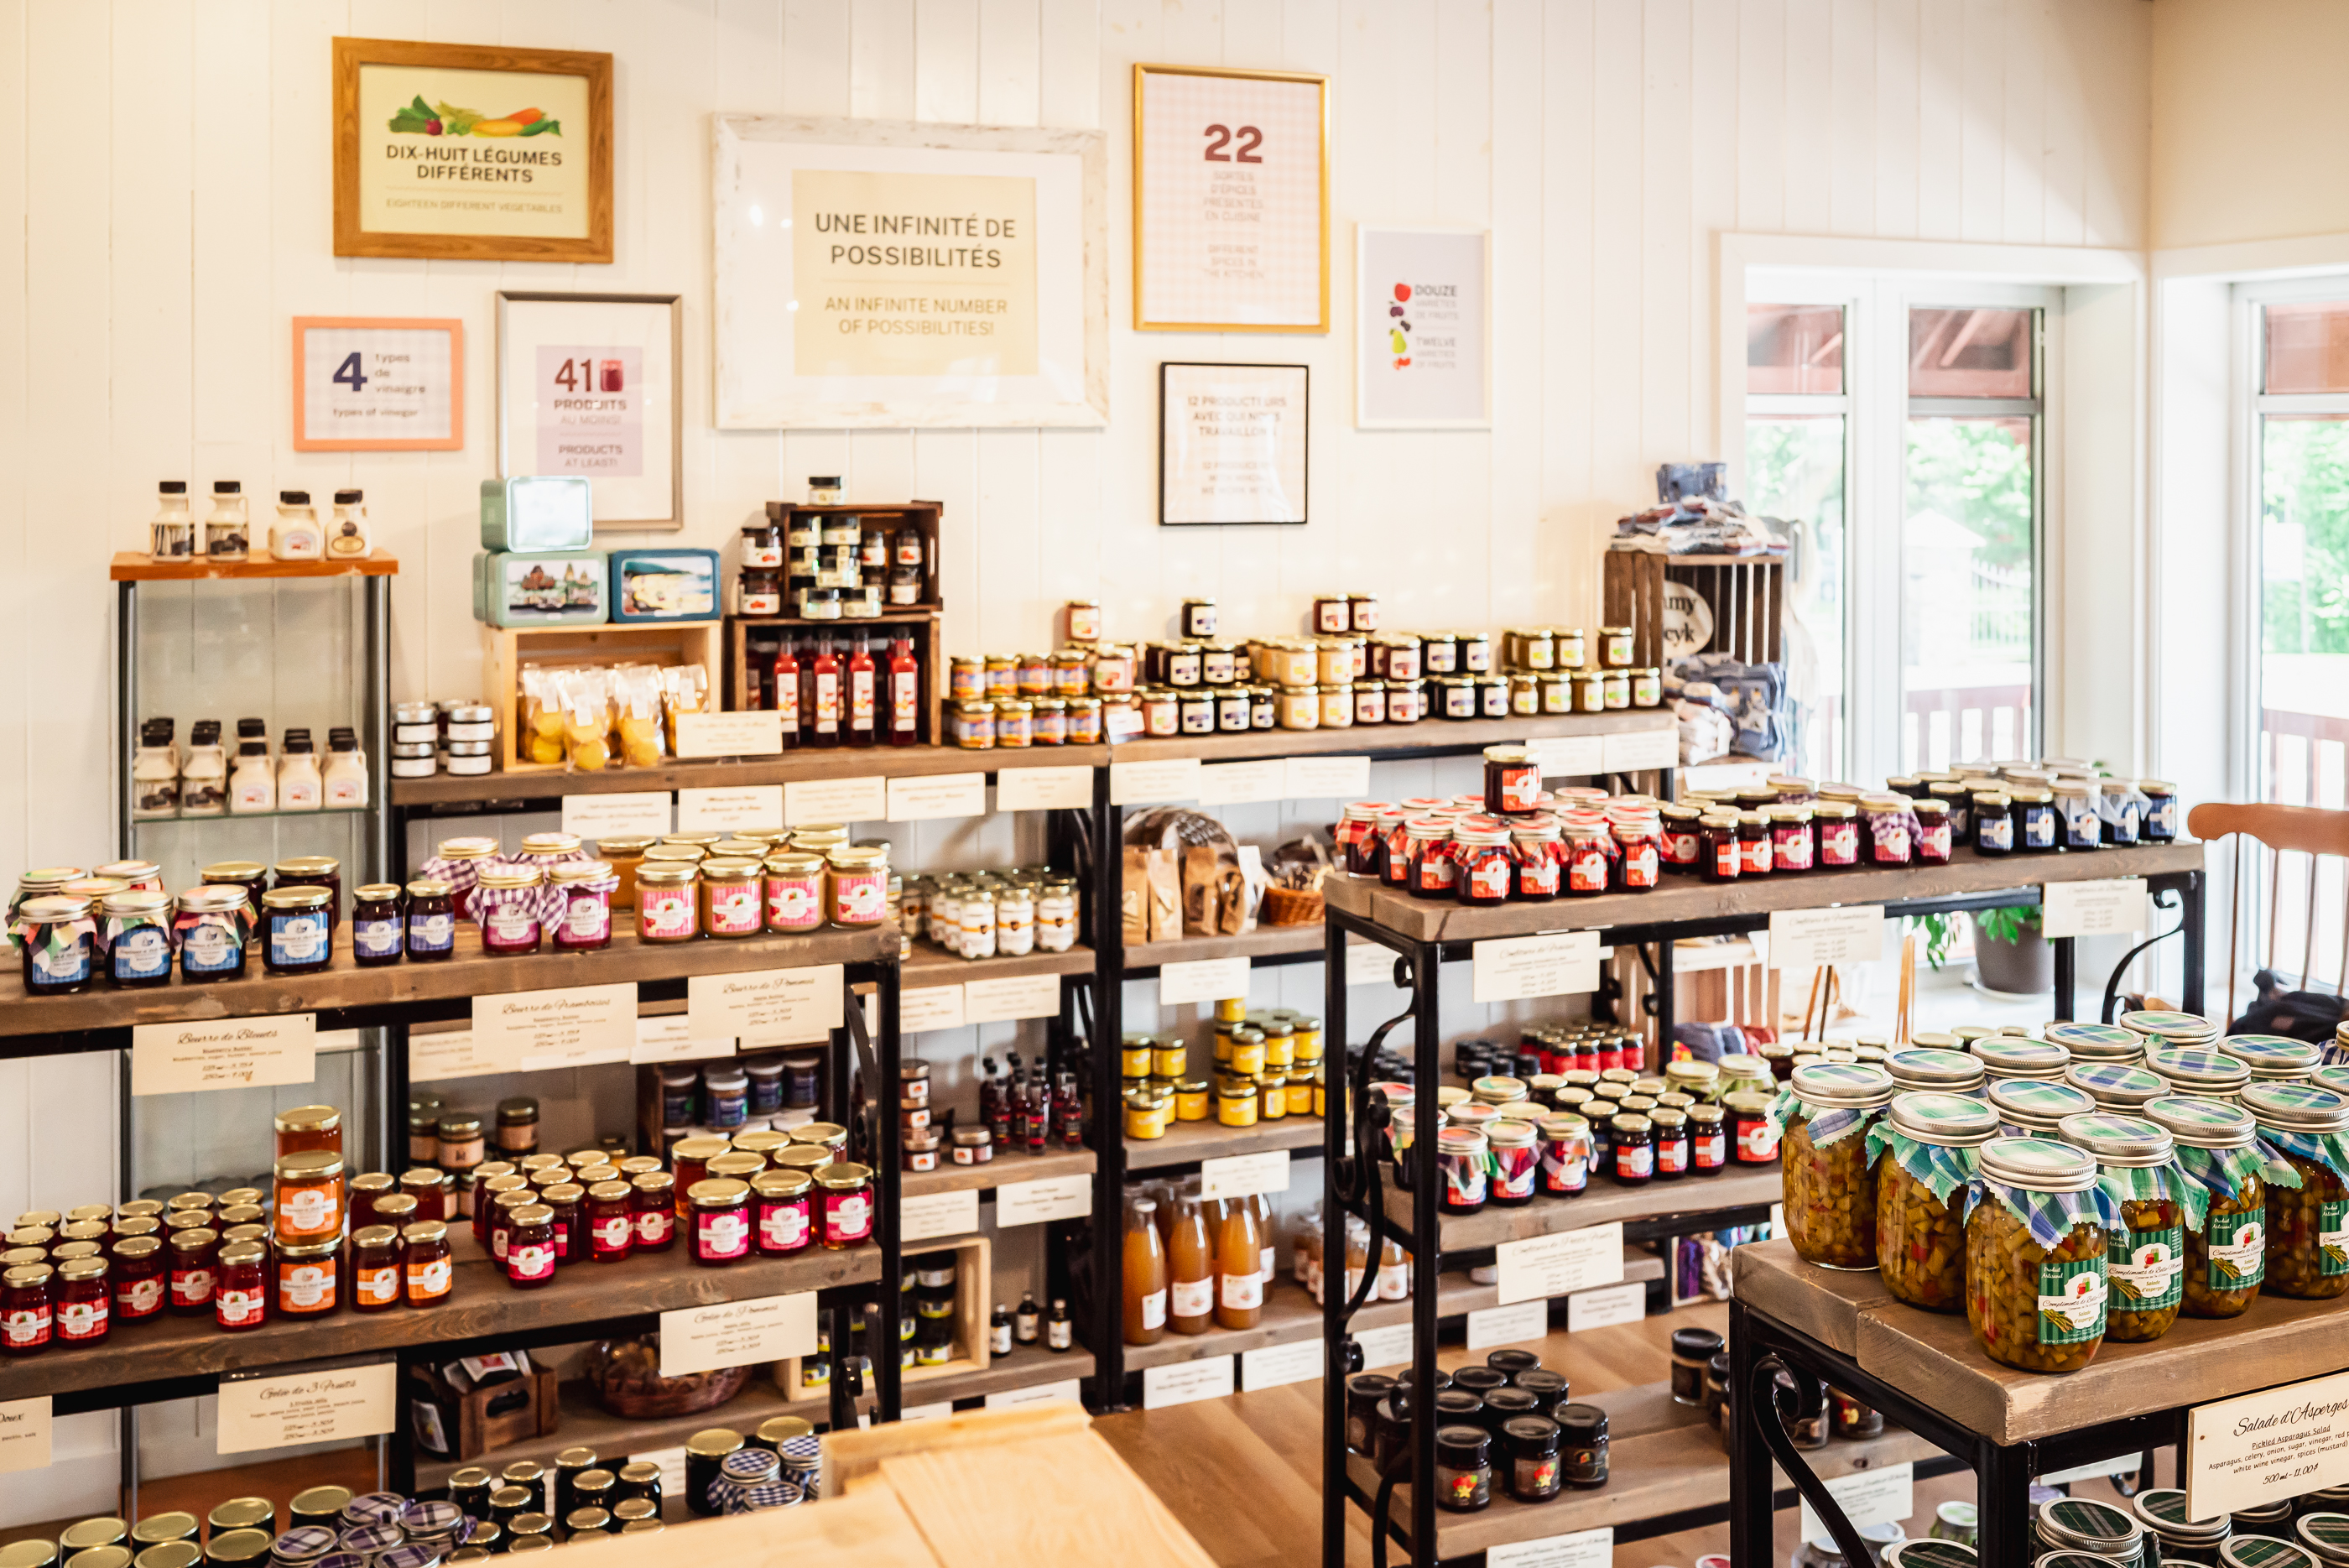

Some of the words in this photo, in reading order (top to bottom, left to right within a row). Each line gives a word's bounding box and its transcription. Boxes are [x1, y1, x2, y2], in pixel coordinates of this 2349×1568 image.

[1203, 124, 1263, 164] 22
[387, 144, 469, 162] DIX-HUIT
[473, 145, 562, 166] LÉGUMES
[417, 163, 534, 184] DIFFÉRENTS
[815, 212, 867, 234] UNE
[873, 213, 980, 237] INFINITÉ
[985, 219, 1016, 238] DE
[831, 243, 1002, 268] POSSIBILITÉS
[1414, 284, 1457, 298] DOUZE
[825, 296, 850, 311] AN
[855, 296, 929, 313] INFINITE
[933, 298, 1008, 315] NUMBER
[839, 318, 862, 335] OF
[867, 319, 995, 336] POSSIBILITIES!
[375, 353, 410, 363] types
[333, 351, 368, 393] 4
[375, 369, 391, 378] de
[555, 357, 591, 393] 41
[375, 386, 426, 395] vinaigre
[333, 408, 363, 418] types
[366, 408, 377, 416] of
[380, 409, 419, 418] vinegar
[554, 399, 628, 411] PRODUITS
[558, 445, 623, 455] PRODUCTS
[177, 1032, 220, 1044] Beurre
[221, 1032, 234, 1041] de
[2108, 1267, 2147, 1275] Compliments
[2042, 1300, 2080, 1308] Compliments
[2232, 1413, 2279, 1437] Salade
[2279, 1399, 2349, 1425] d'Asperges
[2252, 1438, 2276, 1451] Pickled
[2277, 1430, 2311, 1444] Asparagus
[2313, 1424, 2331, 1435] Salad
[2208, 1458, 2243, 1471] Asparagus,
[2244, 1451, 2265, 1463] celery,
[2267, 1446, 2286, 1456] onion,
[2288, 1441, 2307, 1452] sugar,
[2309, 1435, 2334, 1445] vinegar,
[2335, 1430, 2346, 1439] red
[2233, 1464, 2252, 1474] white
[2253, 1460, 2269, 1470] wine
[2270, 1454, 2295, 1466] vinegar,
[2297, 1449, 2316, 1459] spices
[2317, 1440, 2348, 1454] (mustard)
